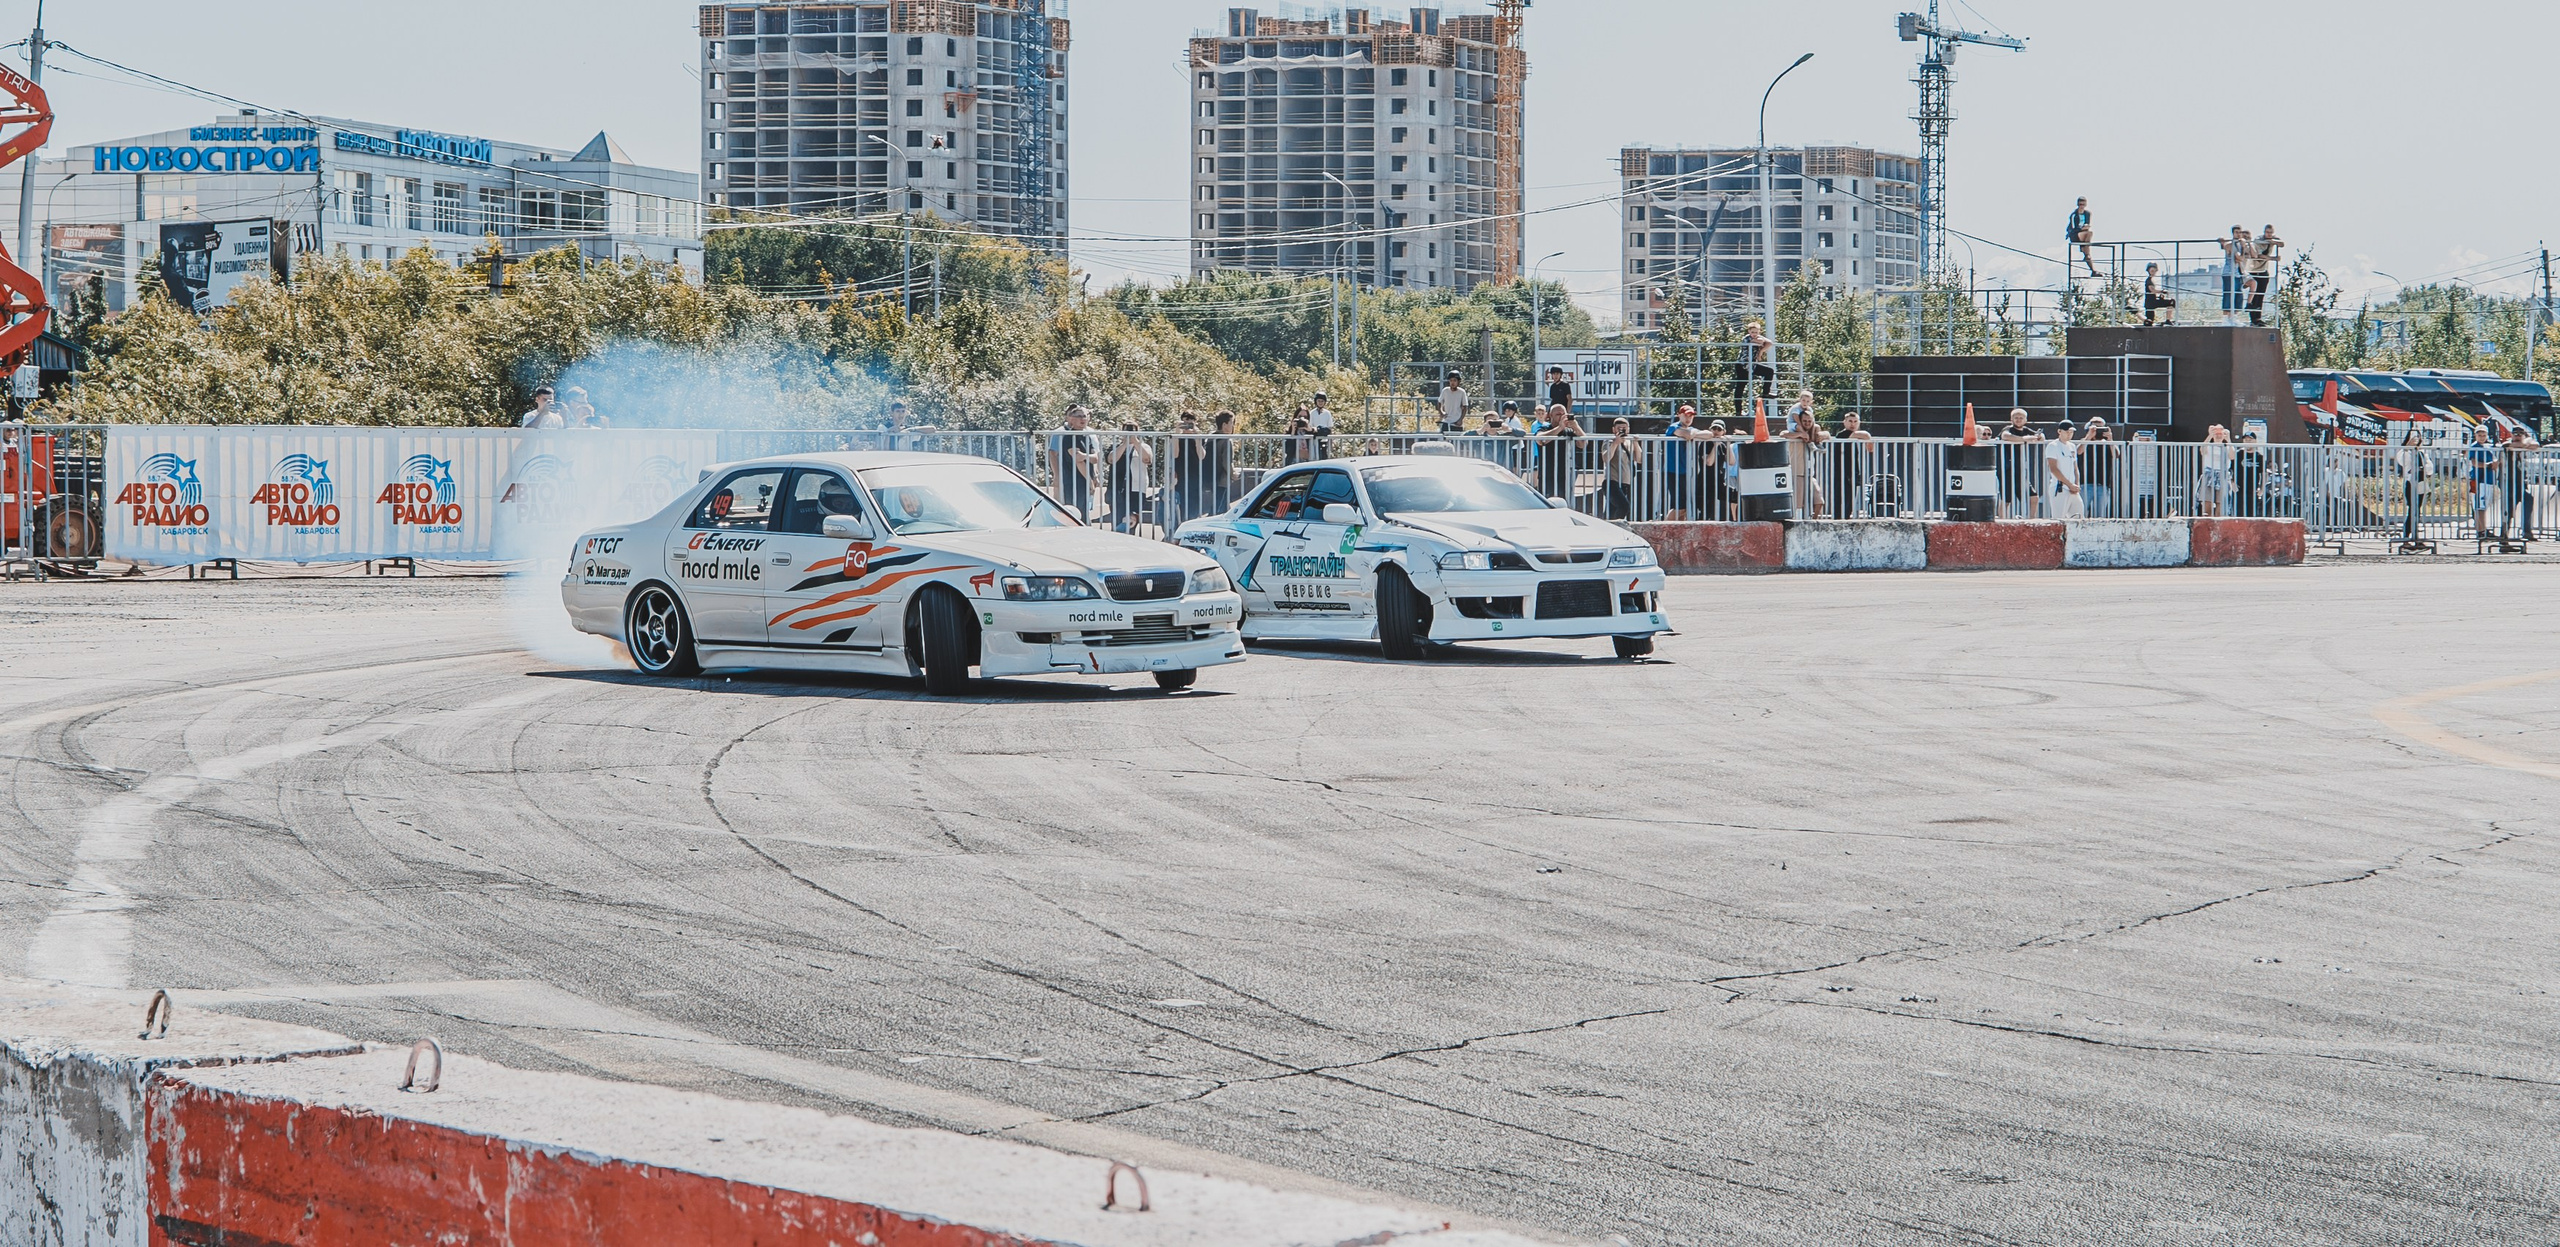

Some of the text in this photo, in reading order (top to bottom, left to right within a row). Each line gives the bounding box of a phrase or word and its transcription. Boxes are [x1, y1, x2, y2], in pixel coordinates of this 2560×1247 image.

[0, 63, 31, 94] T.RU
[190, 127, 318, 144] БИЗНЕС-ЦЕНТР
[94, 143, 319, 172] НОВОСТРОЙ
[397, 130, 492, 166] НОВОСТРОЙ
[233, 238, 268, 256] УДАЛЕННЫЙ
[114, 483, 176, 504] АВТО
[249, 483, 309, 504] АВТО
[375, 483, 433, 504] АВТО
[133, 504, 209, 526] РАДИО
[267, 504, 340, 526] РАДИО
[393, 503, 462, 525] РАДИО
[714, 495, 732, 516] 49
[161, 527, 209, 535] ХАБАРОВСК
[294, 527, 340, 535] ХАБАРОВСК
[1341, 531, 1358, 547] FQ
[597, 537, 624, 554] ТСГ
[681, 556, 761, 581] nord mile
[845, 550, 868, 569] FQ
[1270, 552, 1346, 578] ТРАНСЛАЙН
[596, 565, 631, 579] Магадан
[1283, 584, 1332, 598] СЕРВИС
[1069, 609, 1124, 623] nord mile
[1193, 603, 1233, 618] nord mile
